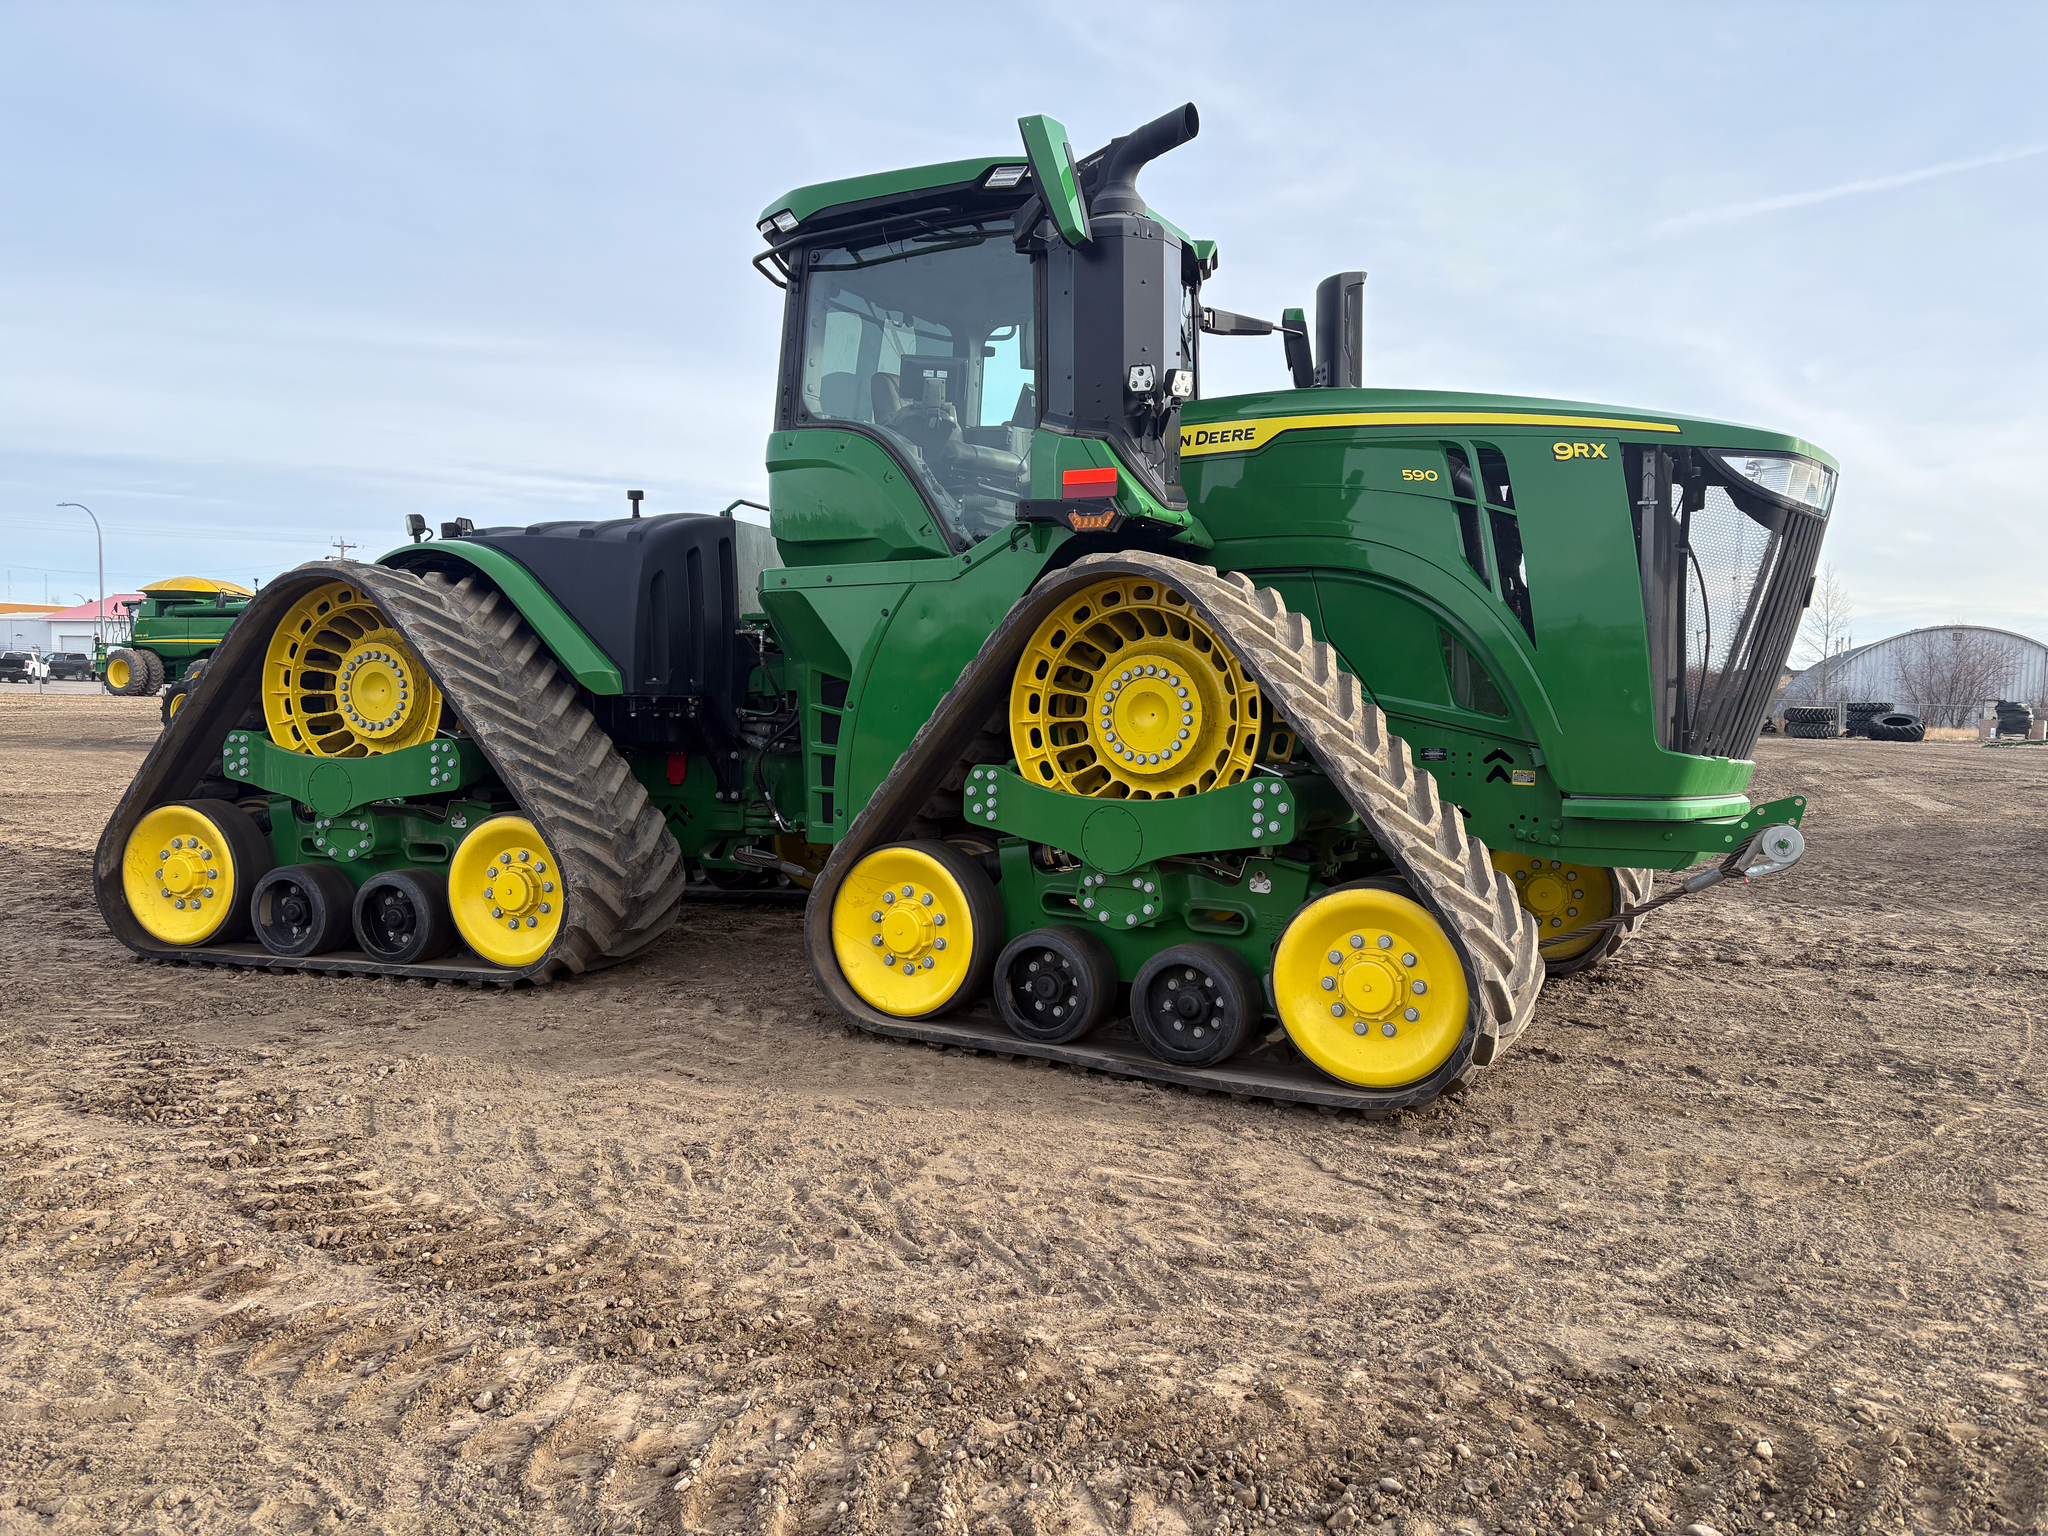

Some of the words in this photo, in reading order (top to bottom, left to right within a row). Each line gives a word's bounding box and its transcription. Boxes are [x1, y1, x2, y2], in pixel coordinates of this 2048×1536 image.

[1195, 427, 1256, 446] DEERE
[1552, 442, 1609, 461] 9RX
[1401, 469, 1439, 482] 590
